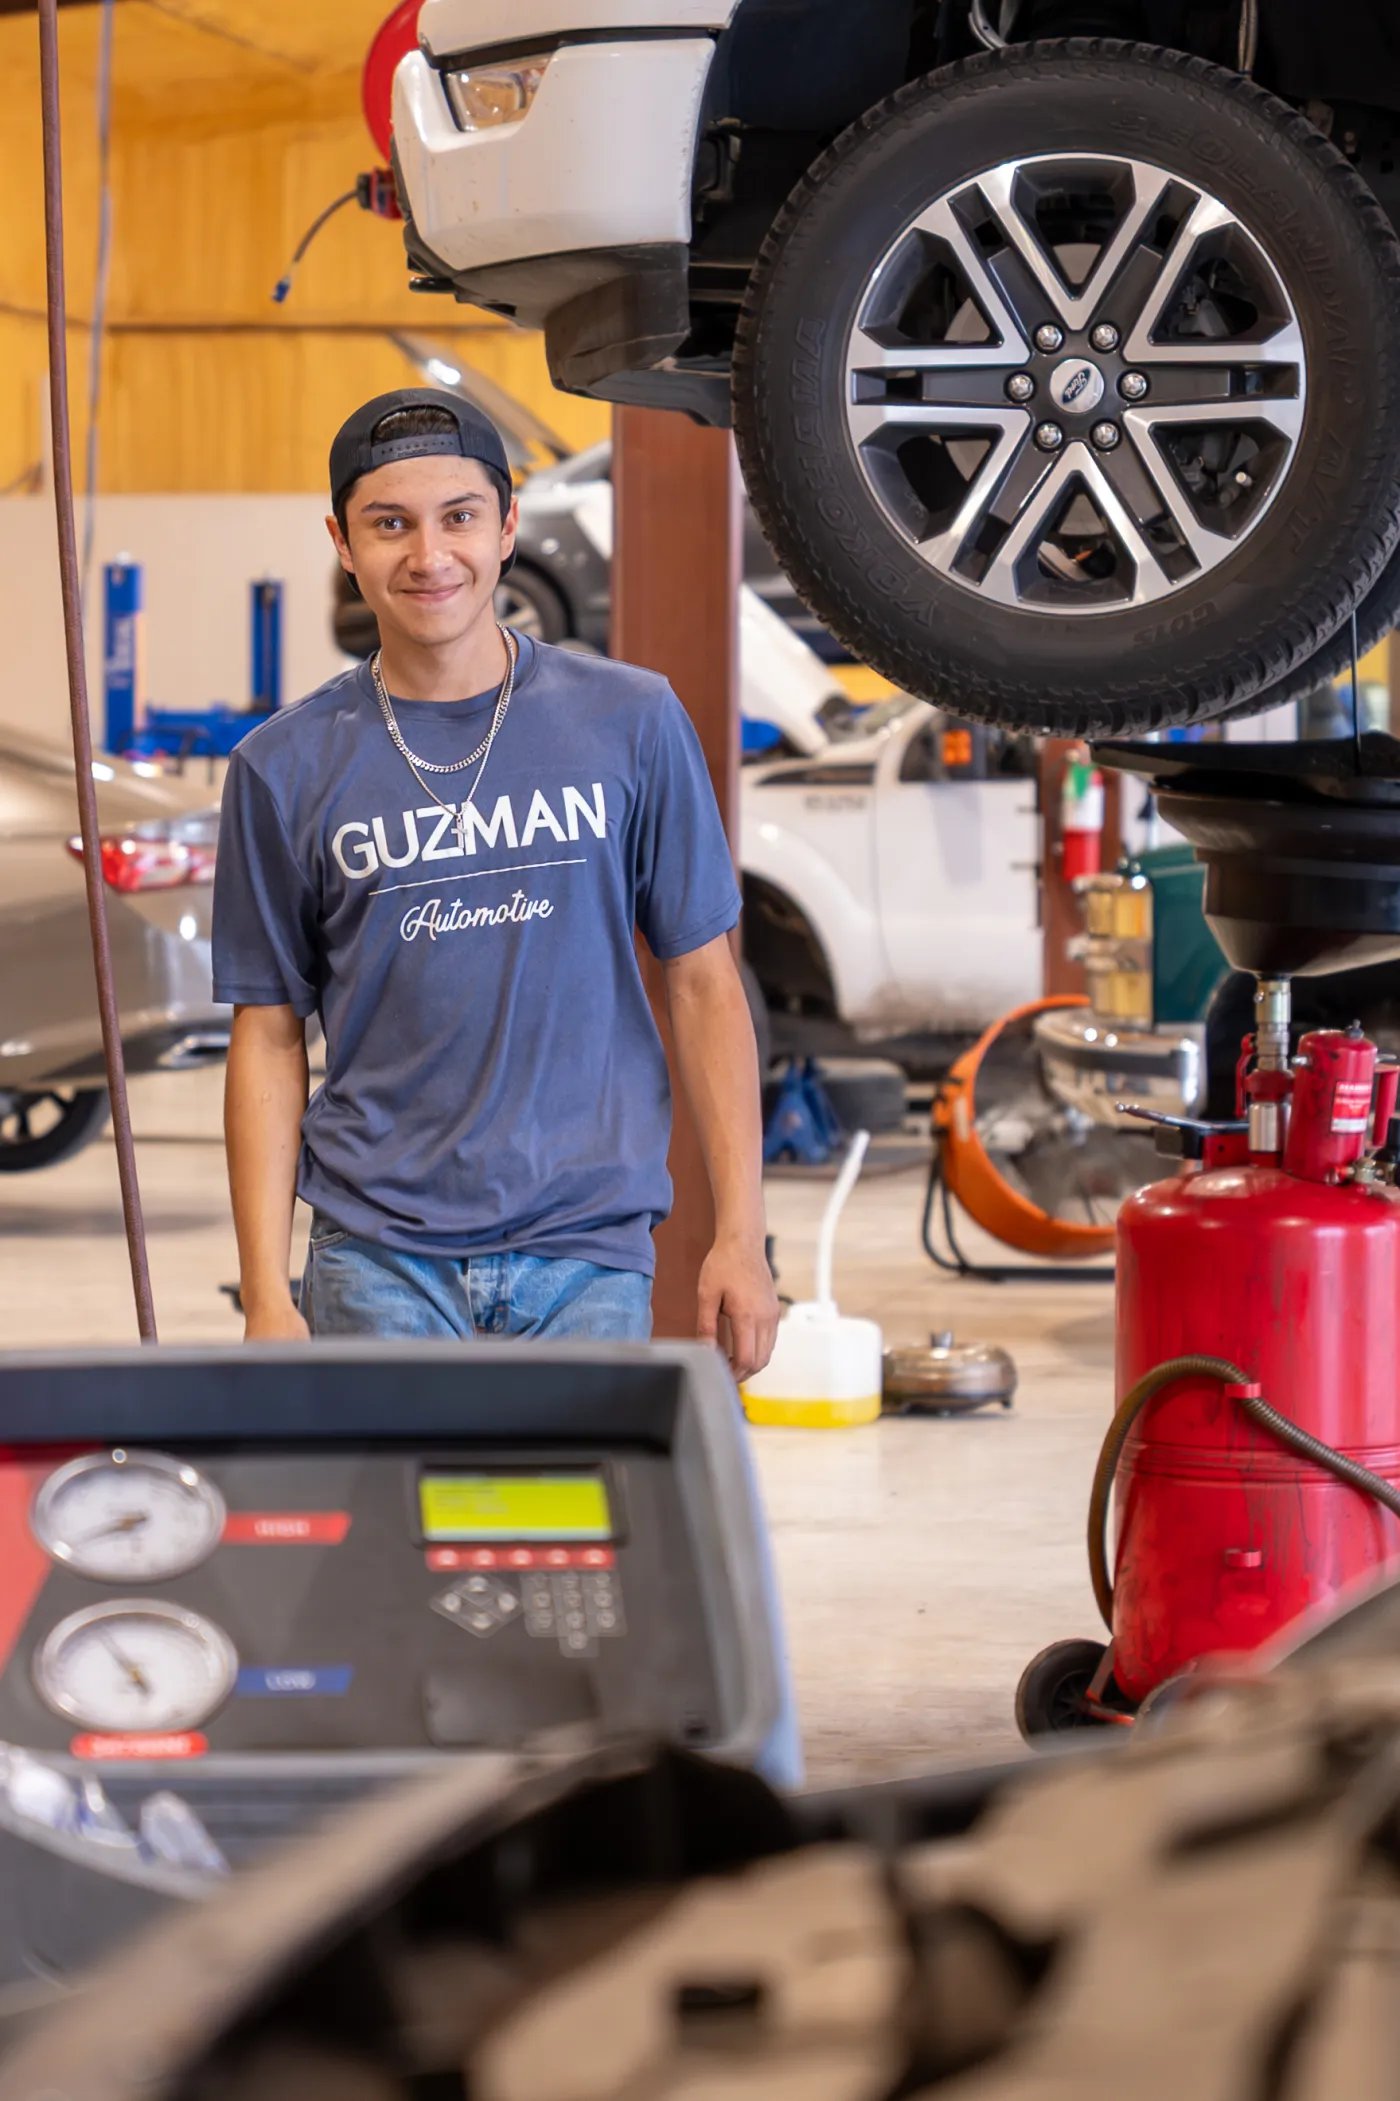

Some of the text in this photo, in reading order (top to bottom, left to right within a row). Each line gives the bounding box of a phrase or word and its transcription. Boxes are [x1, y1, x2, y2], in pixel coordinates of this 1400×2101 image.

[1064, 371, 1088, 400] Ford
[789, 316, 938, 626] YOKOHAMA
[332, 782, 606, 880] GUZMAN
[400, 889, 555, 942] Automotive
